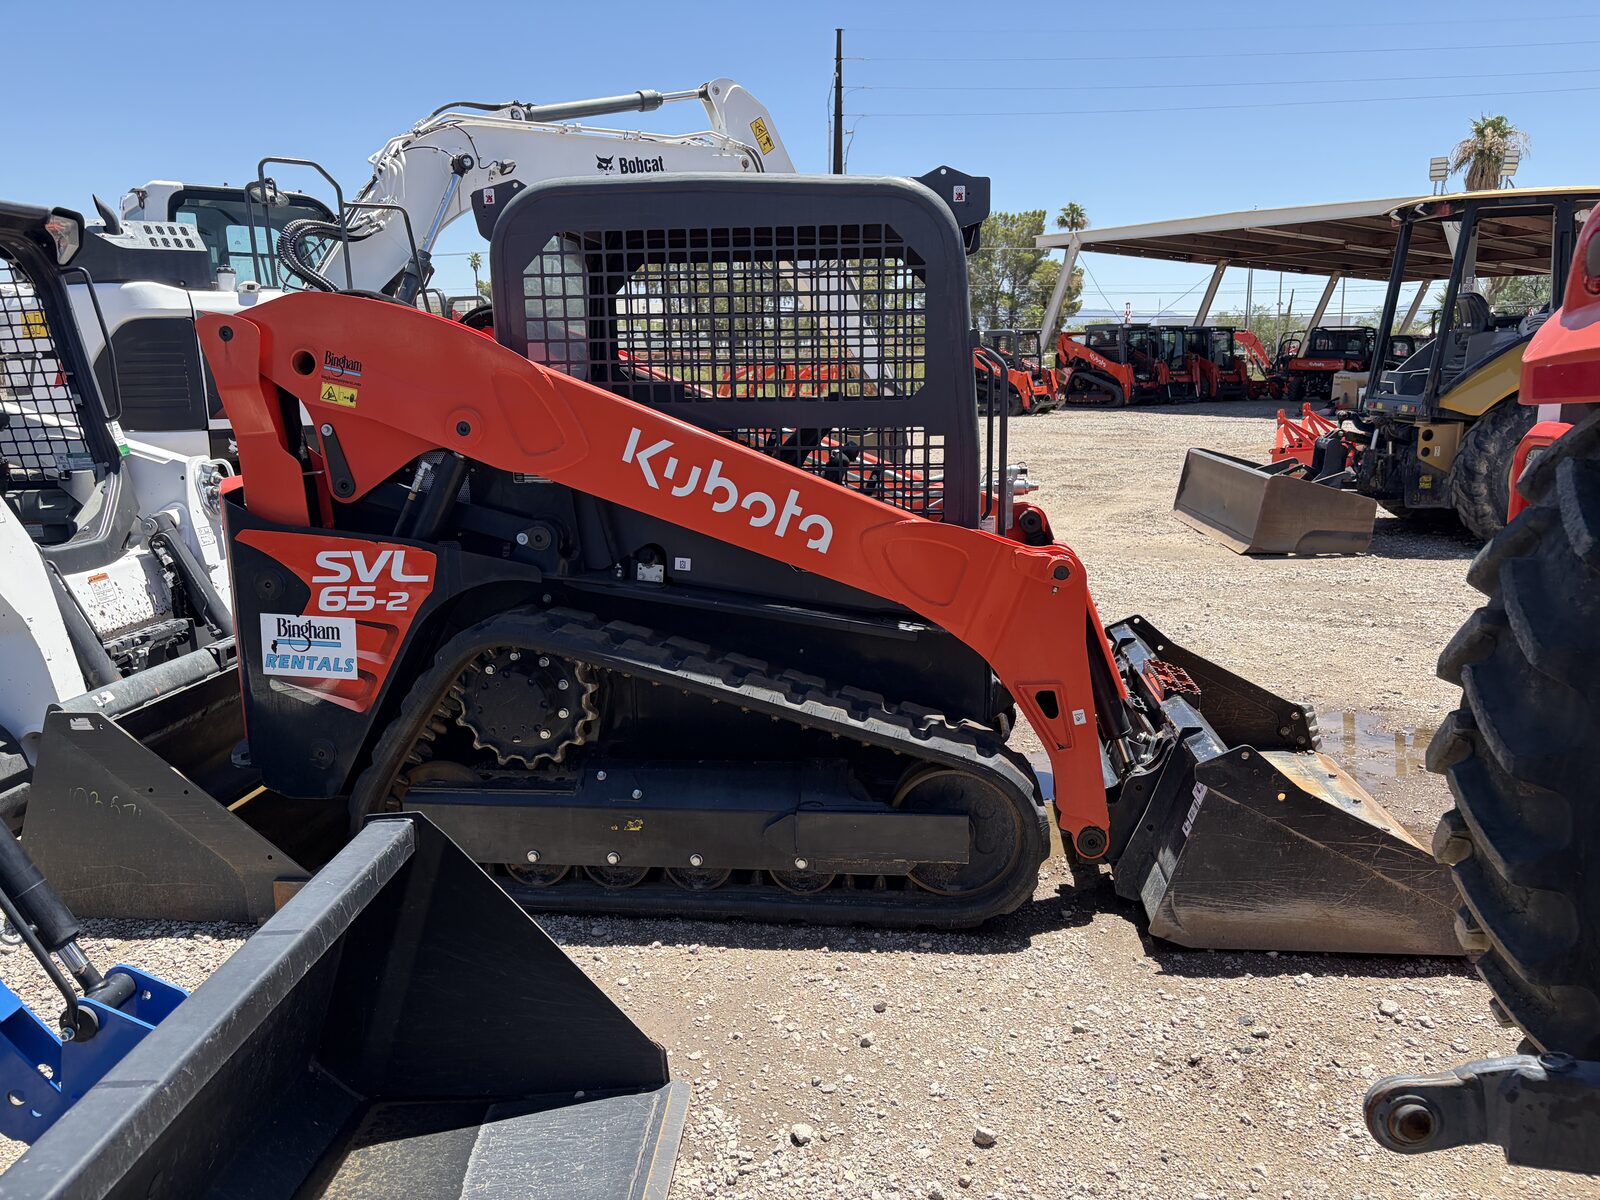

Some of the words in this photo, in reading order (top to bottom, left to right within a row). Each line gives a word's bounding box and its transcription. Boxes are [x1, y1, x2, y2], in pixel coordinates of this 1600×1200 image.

[619, 156, 664, 174] Bobcat
[324, 351, 362, 377] Bingham
[621, 427, 833, 554] Kubota
[312, 550, 429, 583] SVL
[318, 586, 409, 612] 65-2
[276, 618, 341, 652] Bingham
[265, 653, 355, 673] RENTALS
